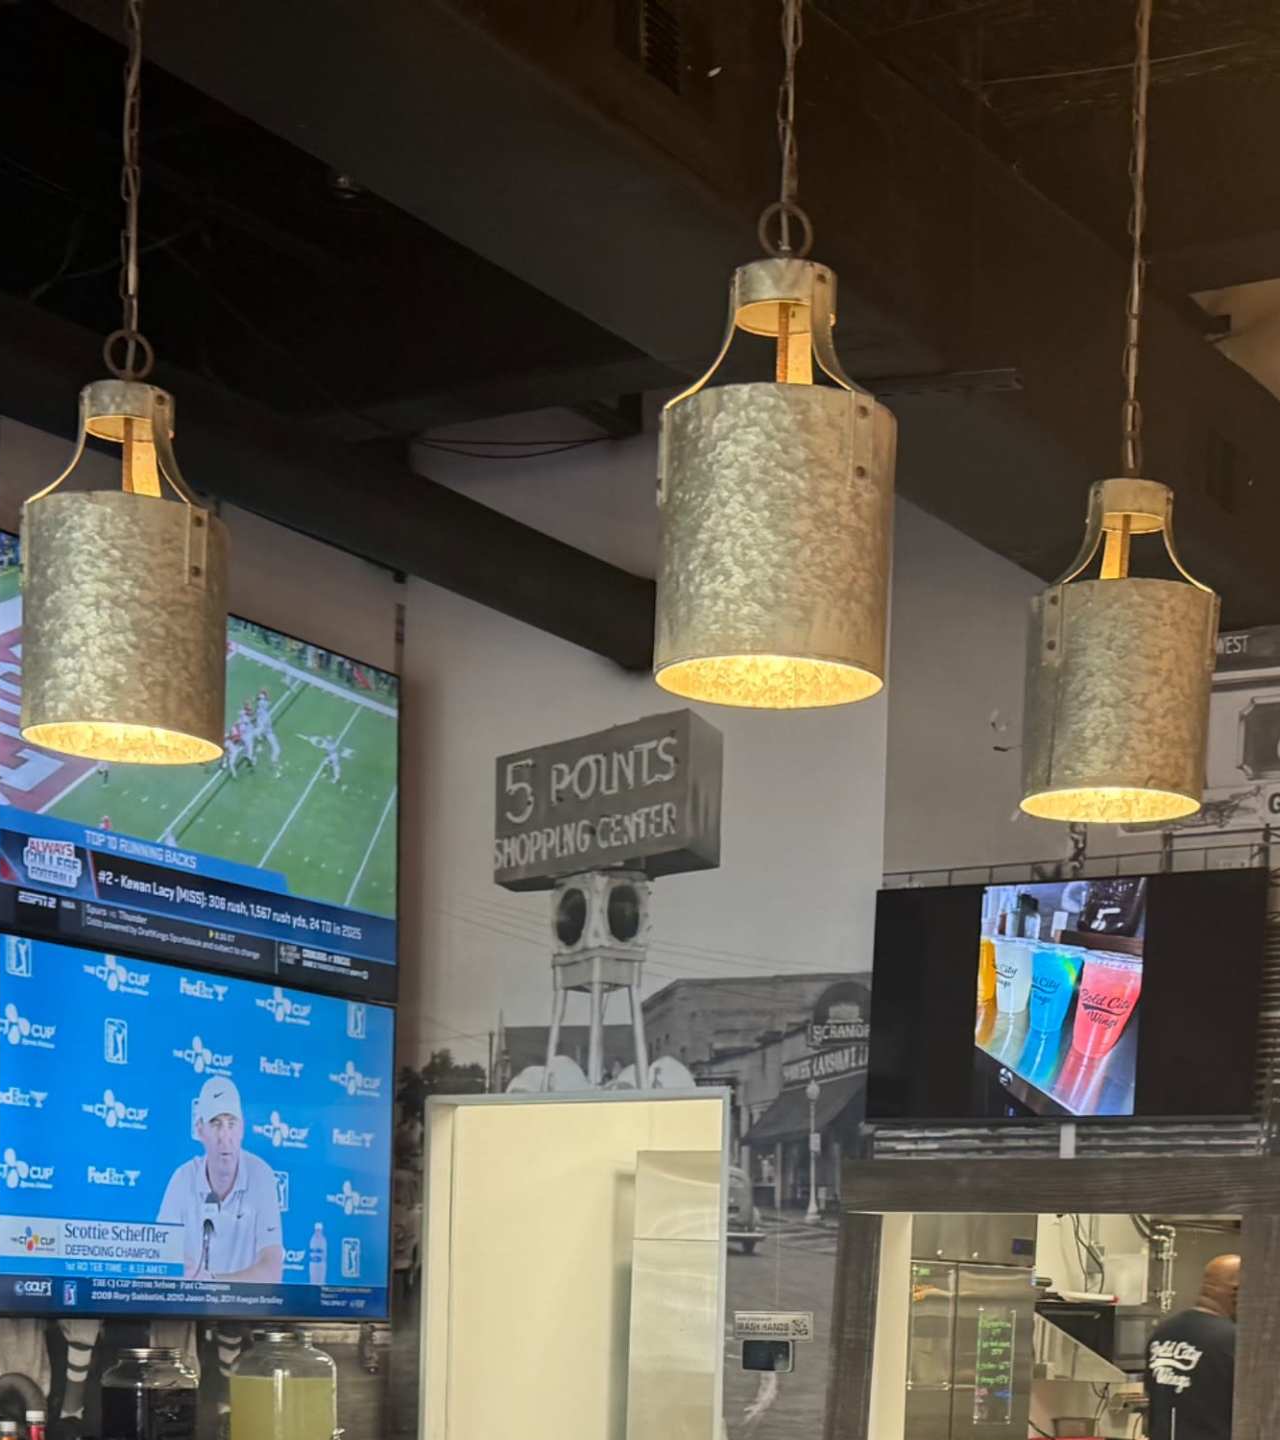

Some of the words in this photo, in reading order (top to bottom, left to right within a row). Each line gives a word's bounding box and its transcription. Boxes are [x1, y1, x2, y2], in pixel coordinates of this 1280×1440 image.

[505, 758, 536, 824] 5
[550, 736, 678, 806] POINTS
[494, 820, 592, 869] SHOPPING
[596, 802, 678, 848] CENTER
[28, 838, 75, 857] ALWAYS
[85, 830, 104, 845] TOP
[107, 835, 117, 849] 10
[120, 838, 163, 861] RUNNING
[164, 849, 197, 870] BACKS
[24, 850, 82, 871] COLLEGE
[29, 866, 78, 886] FOOTBALL
[18, 891, 57, 908] ESPN2
[98, 870, 114, 886] #2
[121, 875, 151, 893] Kewan
[152, 881, 174, 901] Lacy
[272, 910, 291, 926] rush
[31, 1024, 57, 1040] CUP
[30, 1166, 55, 1180] CUP
[64, 1223, 107, 1241] Scottie
[110, 1226, 169, 1245] Scheffler
[64, 1244, 114, 1258] DEFENDING
[115, 1247, 160, 1260] CHAMPION
